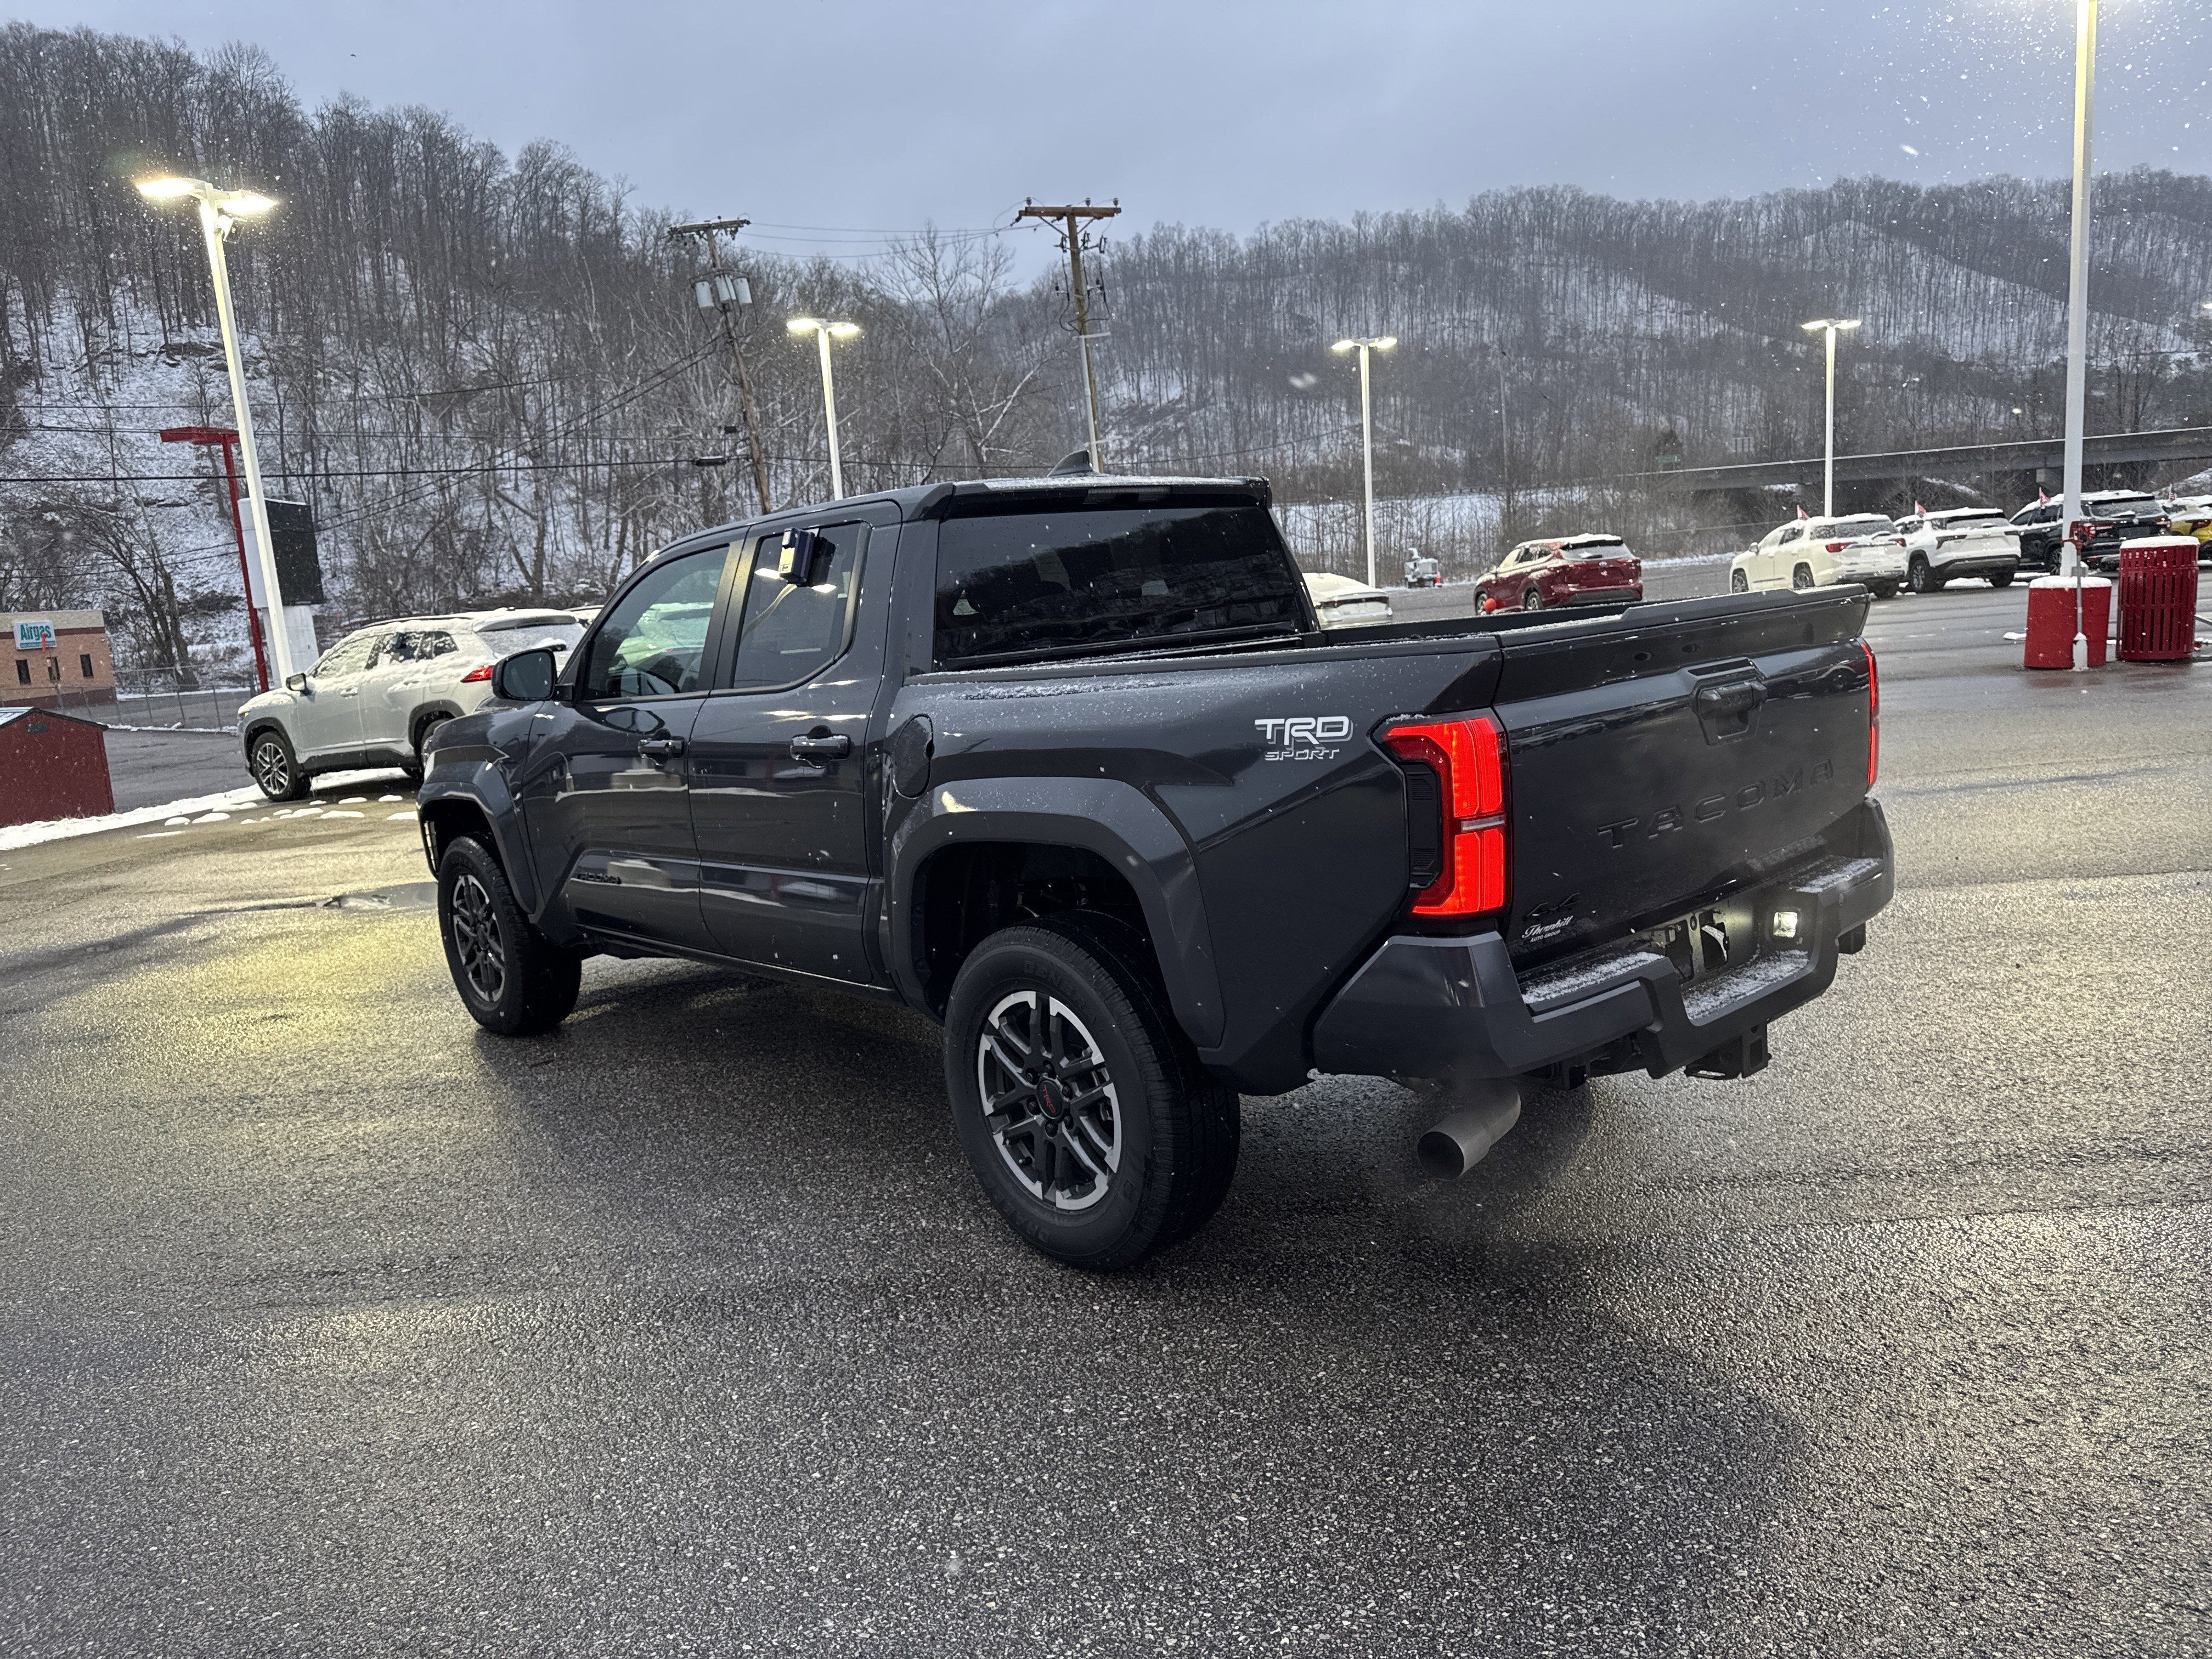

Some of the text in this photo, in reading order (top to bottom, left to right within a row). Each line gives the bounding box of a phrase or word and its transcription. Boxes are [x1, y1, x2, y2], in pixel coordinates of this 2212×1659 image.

[20, 624, 52, 641] Airgas
[1254, 716, 1353, 750] TRD
[1264, 748, 1340, 761] SPORT
[1596, 759, 1835, 849] TACOMA
[1530, 929, 1561, 943] AUTO GROUP
[1024, 960, 1104, 1032] GENERAL
[1043, 1085, 1056, 1114] TRD
